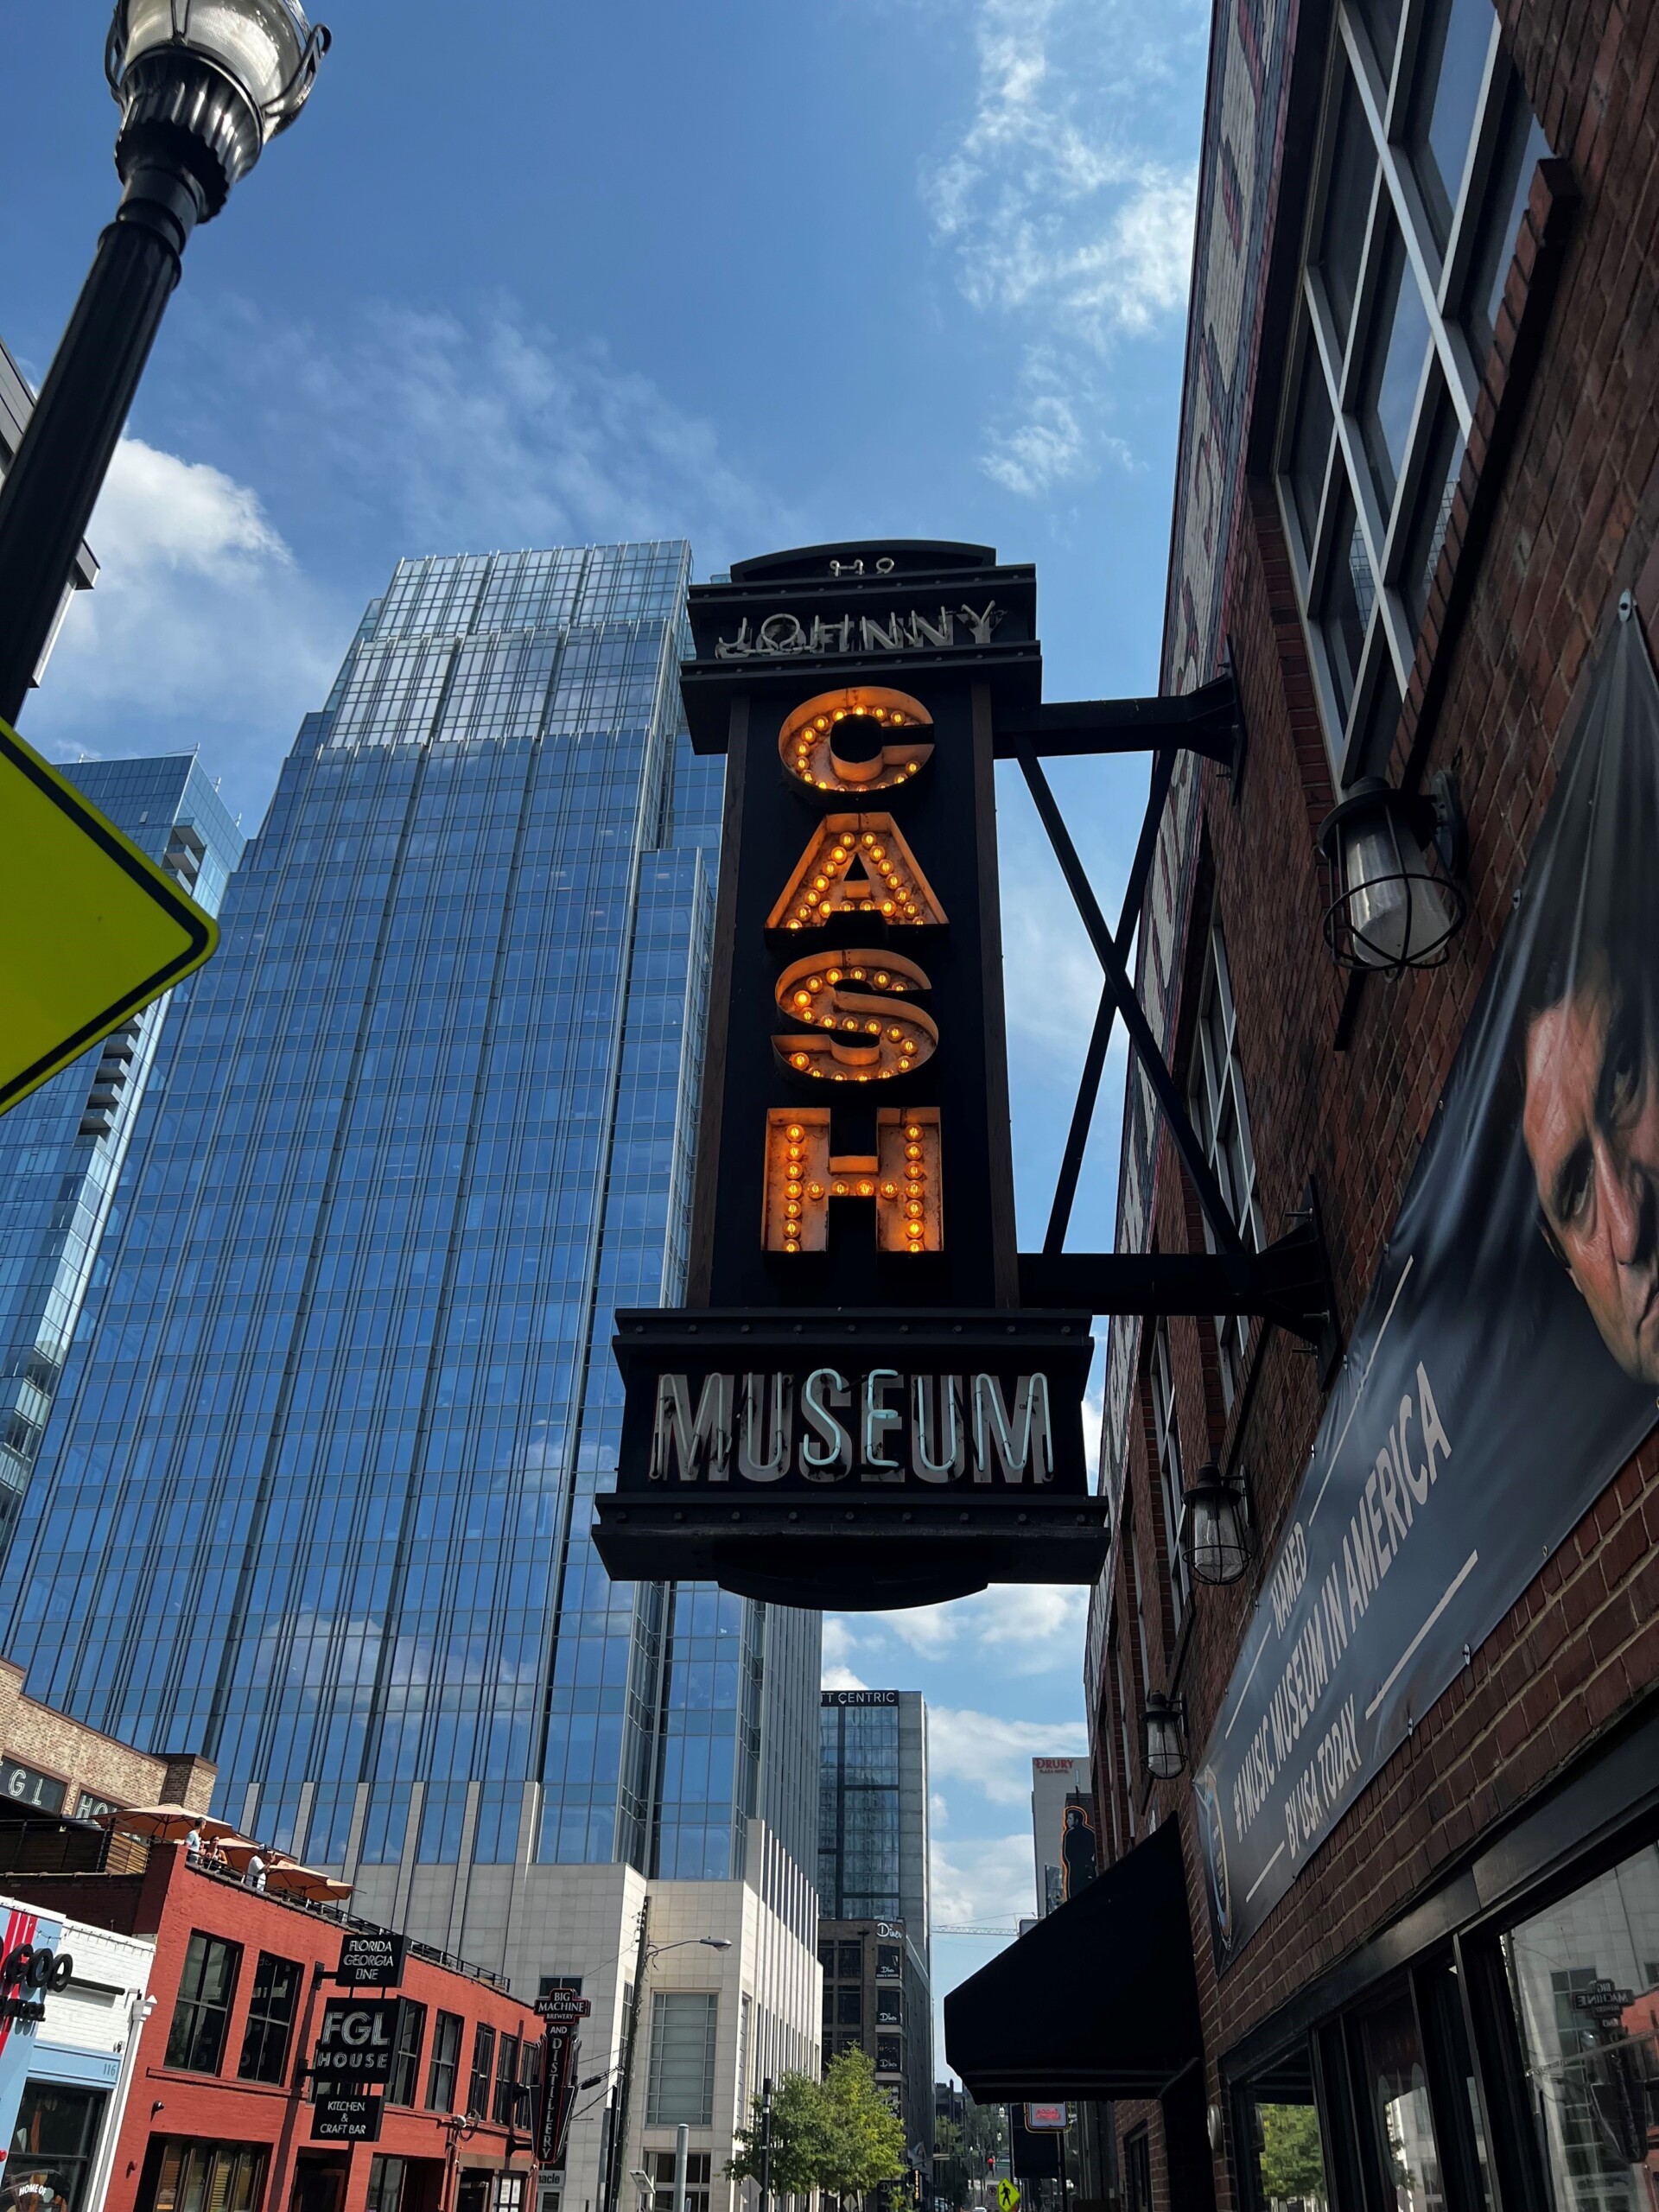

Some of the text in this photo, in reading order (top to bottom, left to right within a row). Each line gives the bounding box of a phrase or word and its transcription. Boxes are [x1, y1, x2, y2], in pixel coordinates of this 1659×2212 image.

[715, 601, 1007, 659] JOHNNY
[761, 686, 950, 1253] CASH
[650, 1369, 1053, 1484] MUSEUM
[1271, 1522, 1307, 1640] NAMED
[1242, 1714, 1275, 1827] MUSIC
[1269, 1603, 1329, 1772] MUSEUM
[1321, 1562, 1348, 1670] IN
[1342, 1360, 1452, 1634] AMERICA
[837, 1692, 895, 1705] CENTRIC
[1034, 1758, 1074, 1769] DRURY
[1284, 1693, 1363, 1860] BY USA TODAY
[349, 1939, 393, 1953] FLORIDA
[343, 1954, 394, 1967] GEORGIA
[554, 1992, 571, 2002] BIG
[537, 2001, 585, 2012] MACHINE
[321, 2011, 391, 2046] FGL
[550, 2025, 568, 2035] AND
[316, 2051, 389, 2069] HOUSE
[103, 2063, 117, 2076] 116
[542, 2037, 563, 2160] DISTILLERY
[327, 2101, 365, 2112] KITCHEN
[340, 2113, 348, 2123] &
[320, 2123, 366, 2134] CRAFT BAR
[19, 2183, 48, 2196] HOME OF
